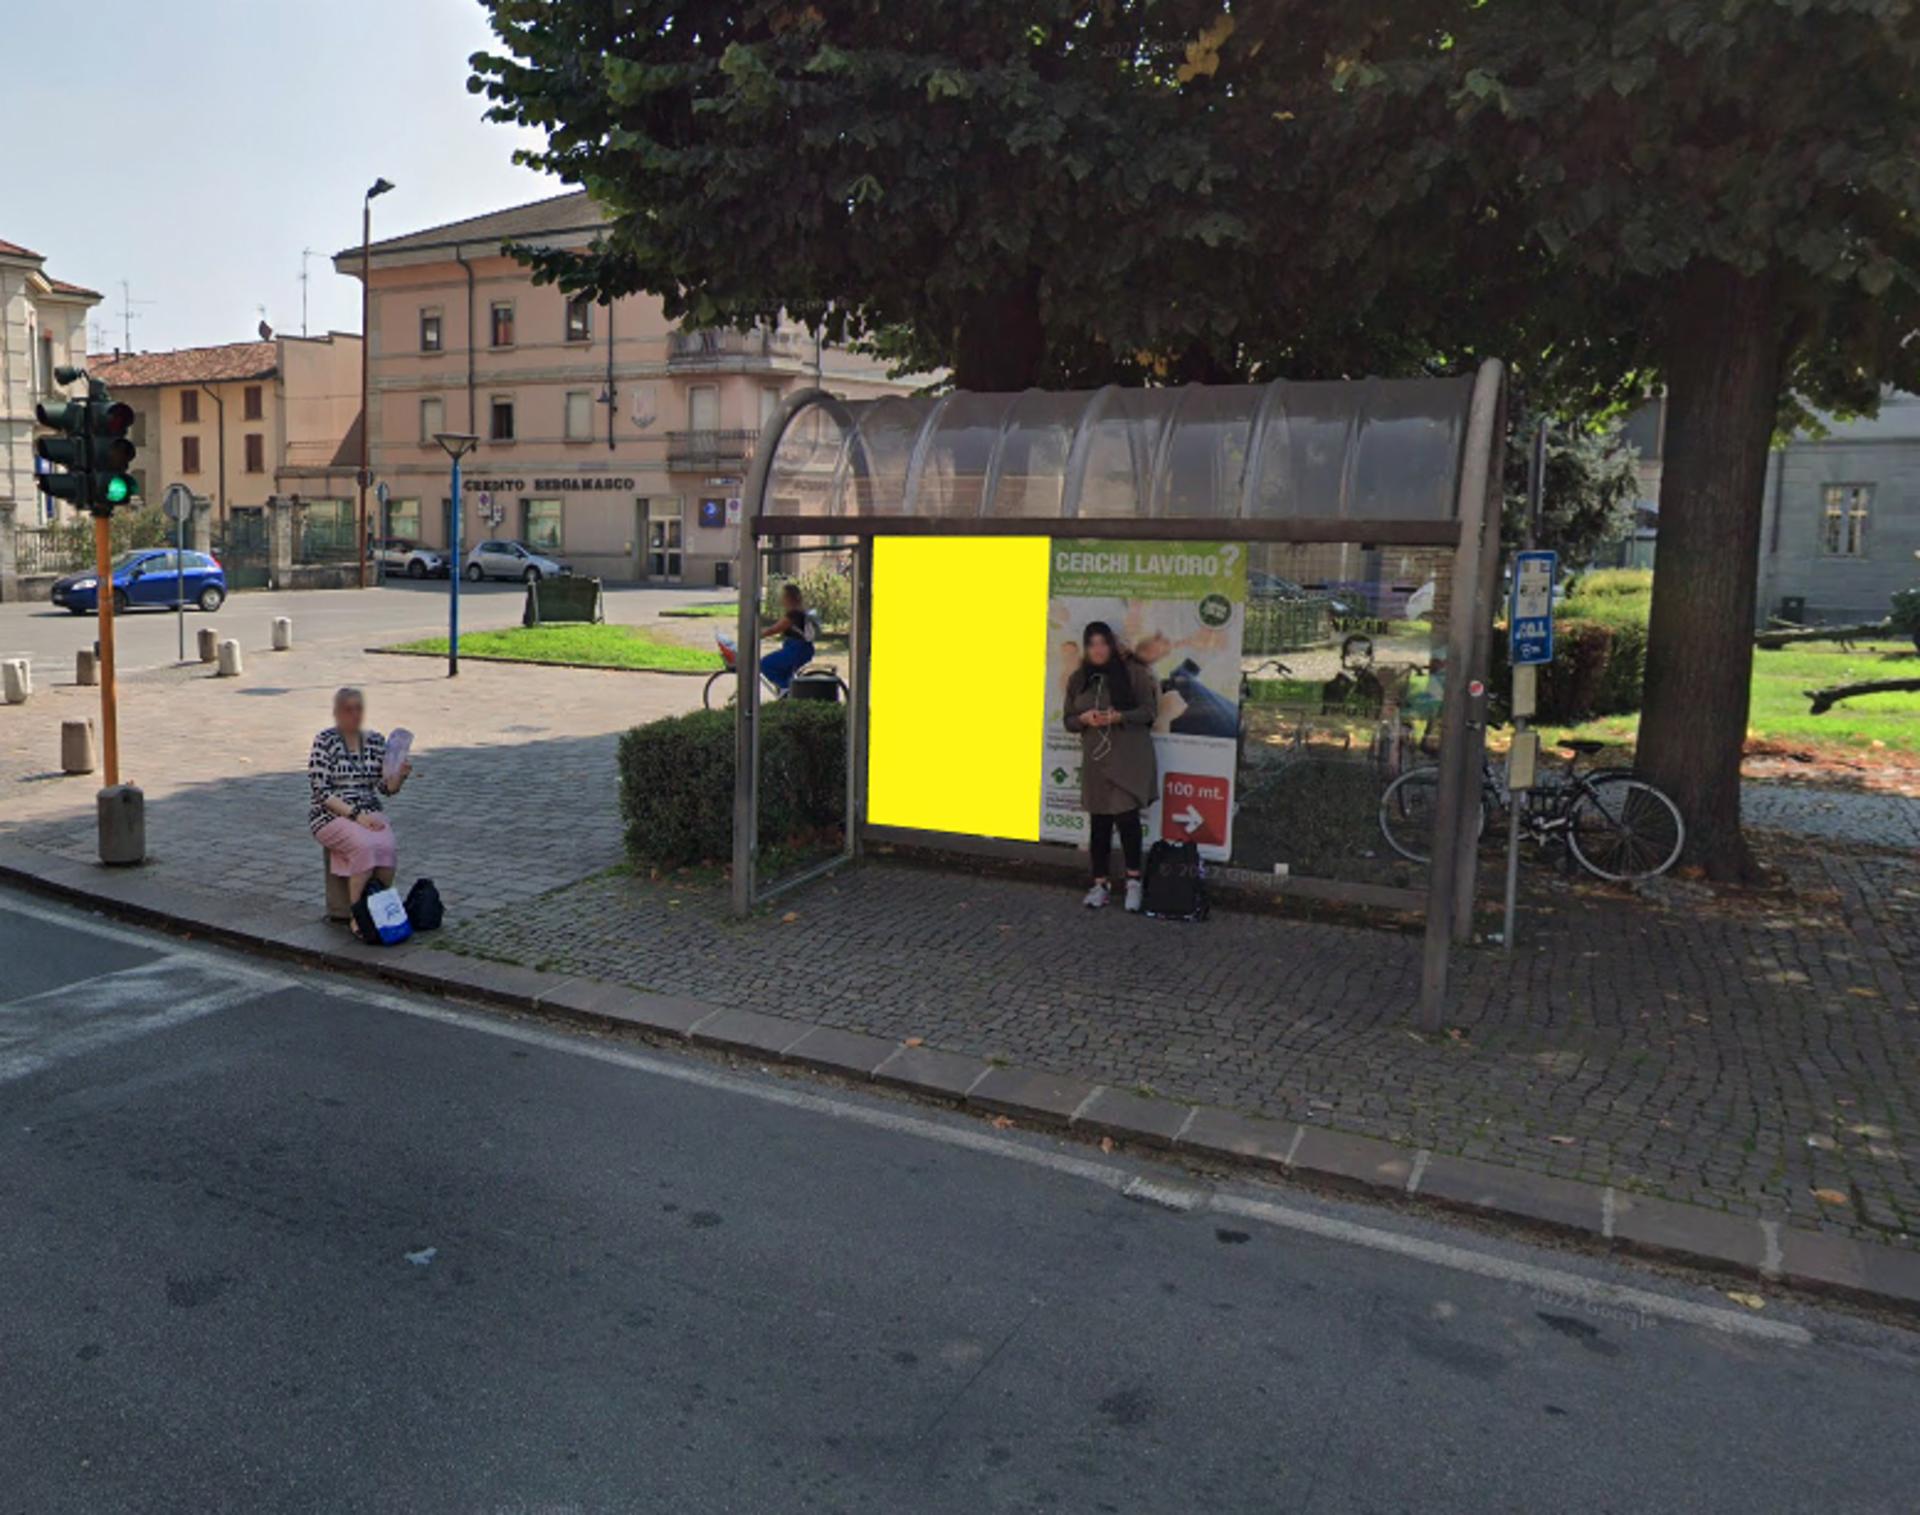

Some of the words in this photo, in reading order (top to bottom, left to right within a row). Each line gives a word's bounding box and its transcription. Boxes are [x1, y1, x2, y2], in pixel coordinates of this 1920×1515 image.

[463, 479, 525, 492] CREDITO
[534, 478, 636, 492] BERGAMASCO
[1055, 552, 1129, 574] CERCHI
[1166, 780, 1195, 797] 100
[1198, 786, 1225, 801] mt.
